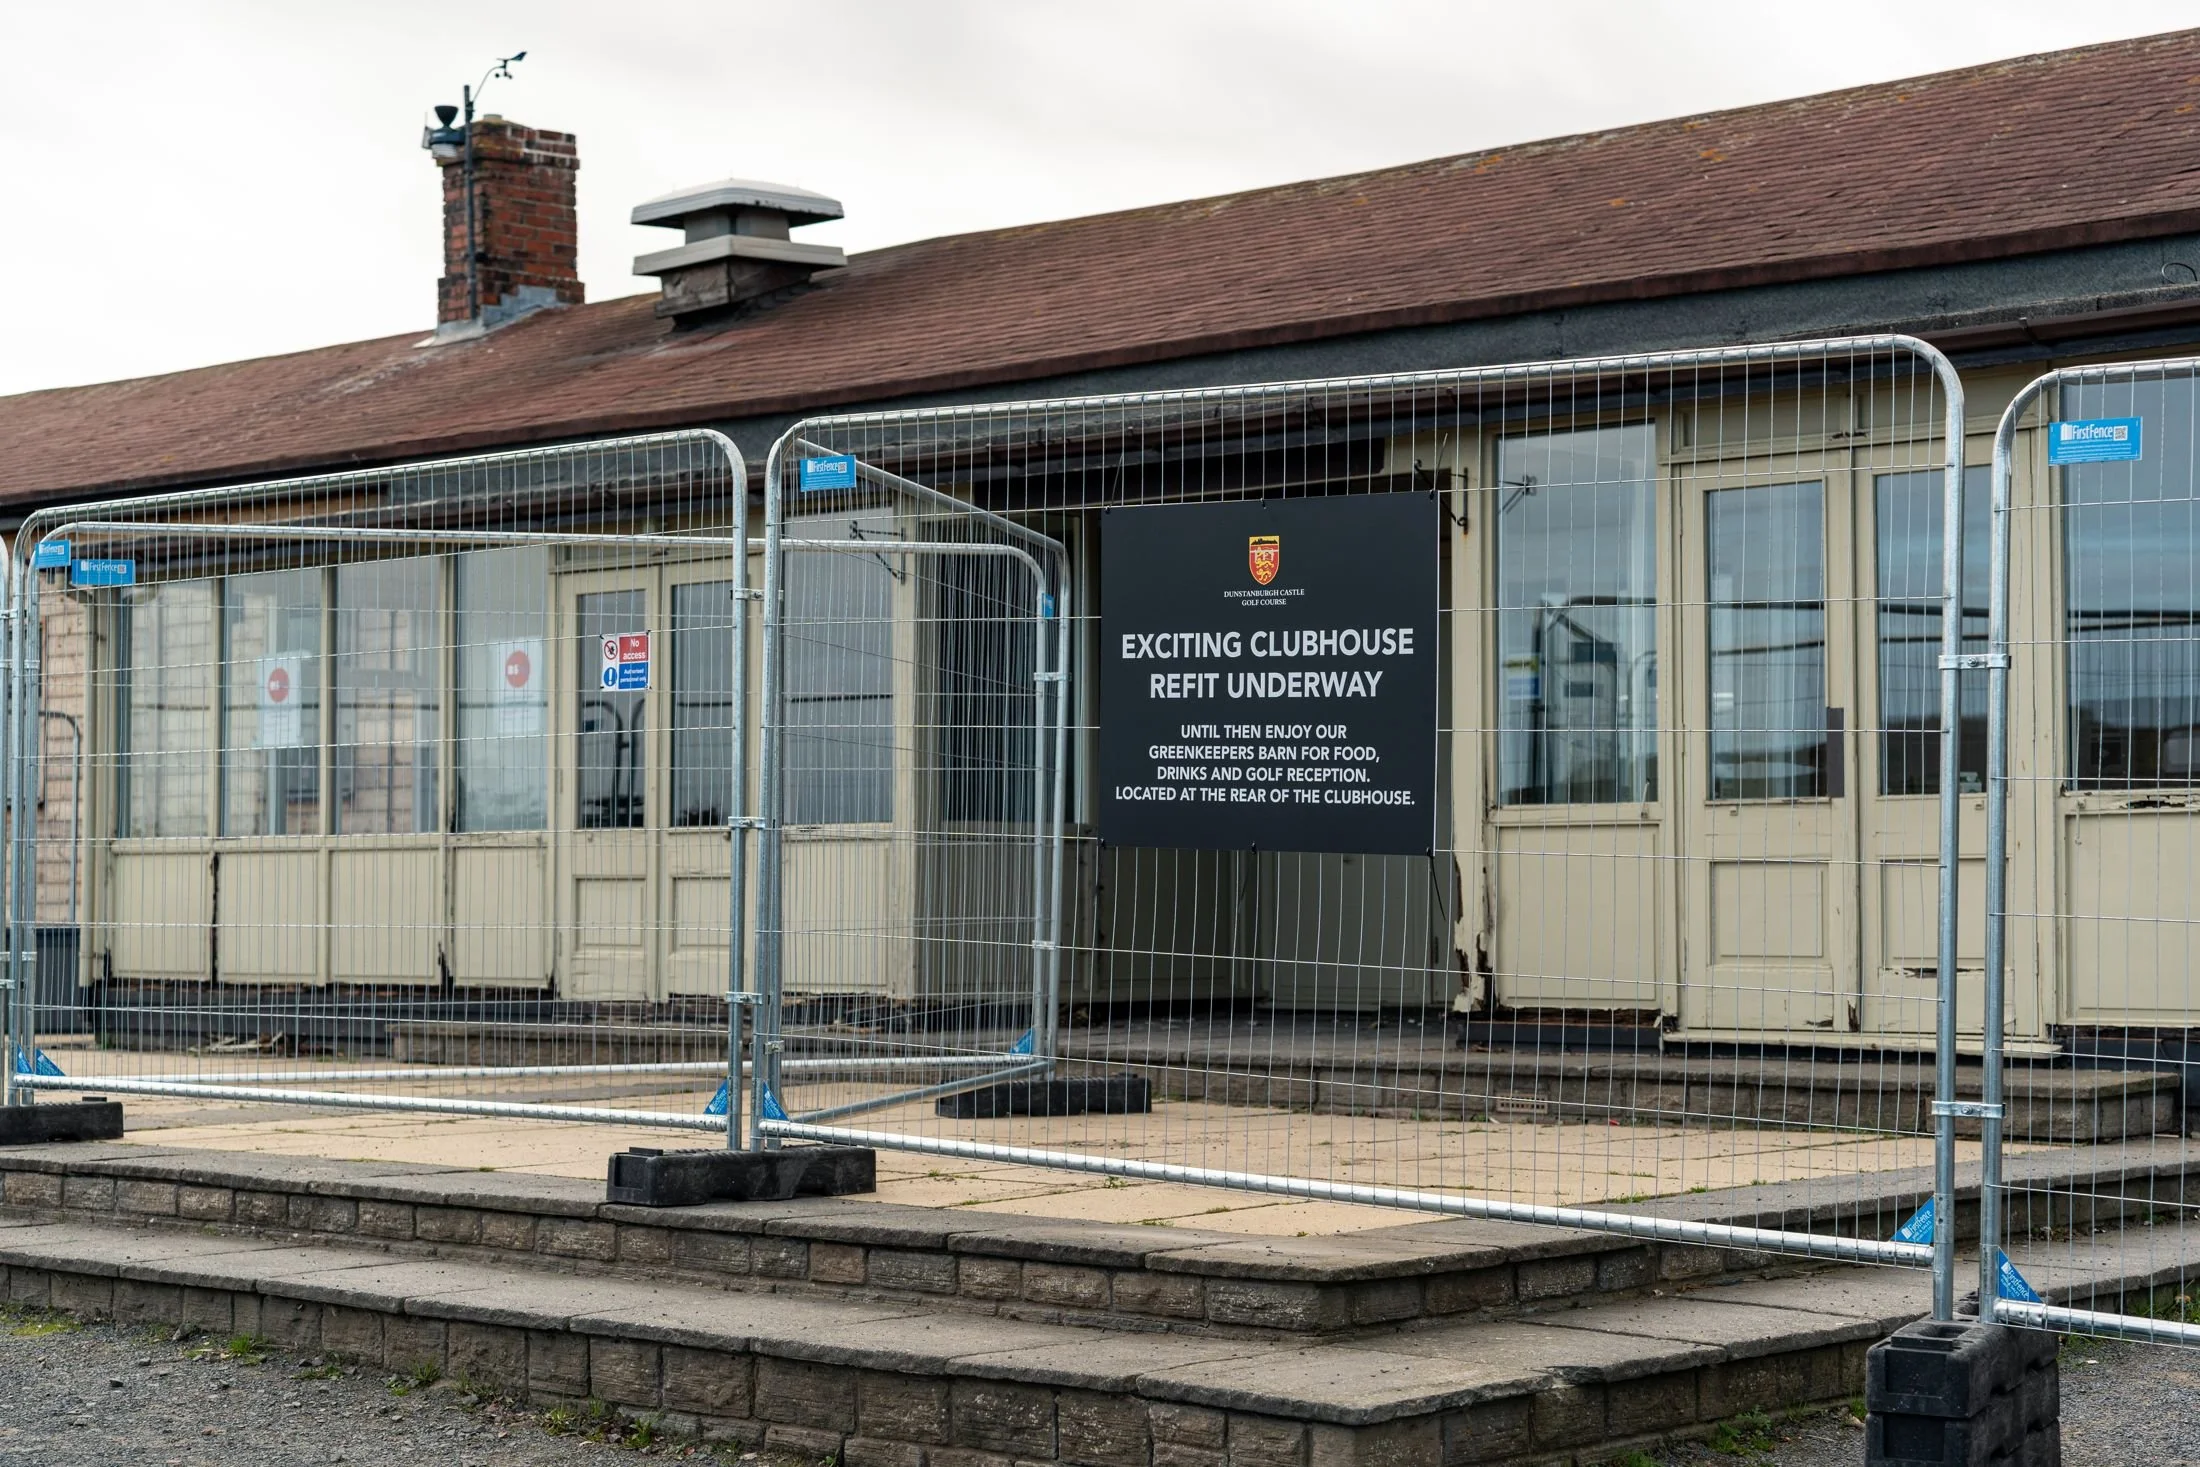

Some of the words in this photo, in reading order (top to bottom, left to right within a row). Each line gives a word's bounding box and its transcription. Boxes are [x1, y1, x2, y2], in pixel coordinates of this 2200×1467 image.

[2072, 424, 2113, 439] FirstFence
[1223, 589, 1279, 598] DUNSTANBURGH
[1280, 588, 1305, 596] CASTLE
[1260, 598, 1287, 606] COURSE
[630, 639, 640, 648] No
[1122, 631, 1242, 659] EXCITING
[1250, 628, 1414, 657] CLUBHOUSE
[623, 652, 646, 660] access
[1150, 672, 1220, 699] REFIT
[1227, 671, 1384, 699] UNDERWAY
[1181, 724, 1221, 739] UNTIL
[1223, 724, 1261, 739] THEN
[1265, 724, 1312, 739] ENJOY
[1315, 724, 1347, 739] OUR
[1148, 744, 1255, 760] GREENKEEPERS
[1258, 745, 1297, 760] BARN
[1301, 746, 1330, 761] FOR
[1333, 746, 1380, 763] FOOD,
[1157, 766, 1208, 780] DRINKS
[1210, 766, 1243, 781] AND
[1245, 767, 1283, 782] GOLF
[1287, 767, 1371, 783] RECEPTION.
[1115, 786, 1177, 801] LOCATED
[1179, 787, 1197, 801] AT
[1200, 787, 1226, 802] THE
[1230, 788, 1267, 803] REAR
[1269, 788, 1290, 803] OF
[1293, 789, 1321, 804] THE
[1324, 789, 1416, 806] CLUBHOUSE.
[1909, 1210, 1932, 1234] FirstFence
[2008, 1270, 2030, 1299] FirstFence
